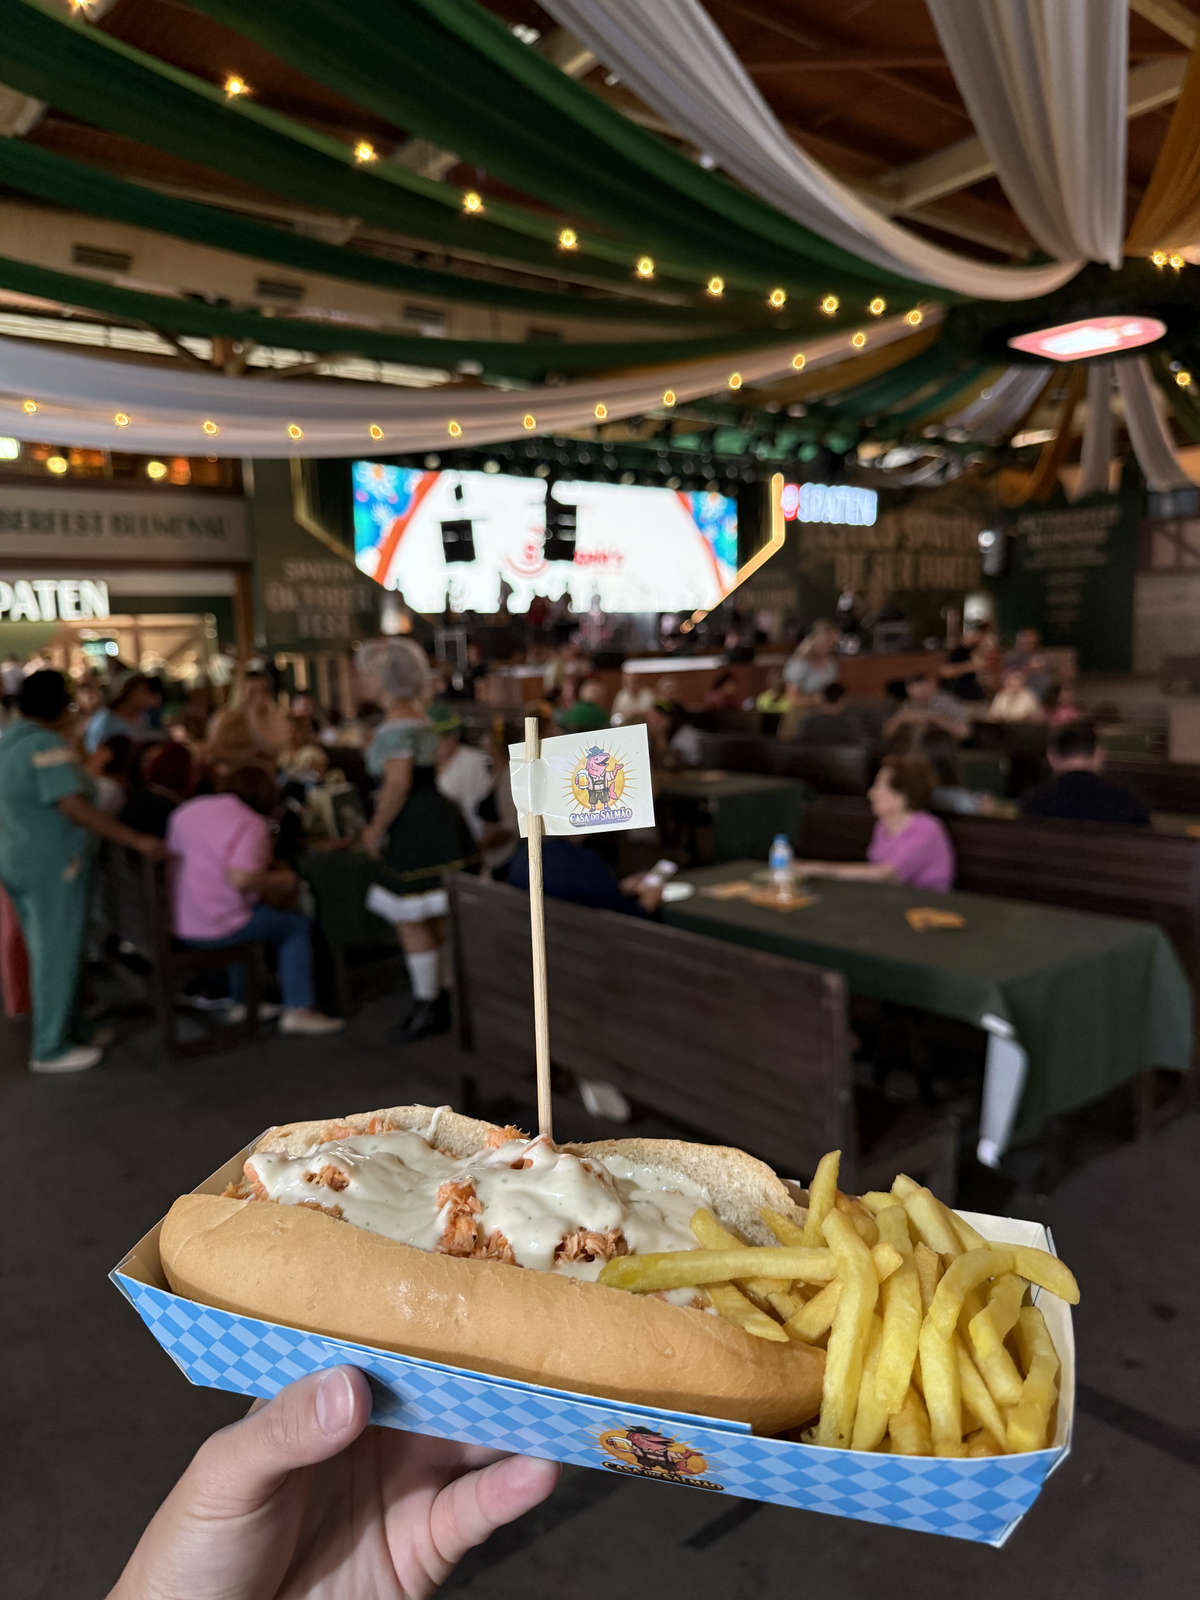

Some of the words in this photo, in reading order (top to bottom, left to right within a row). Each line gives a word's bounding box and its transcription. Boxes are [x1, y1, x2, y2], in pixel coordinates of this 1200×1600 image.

[798, 482, 878, 526] SPATEN
[0, 580, 110, 622] PATEN
[570, 813, 589, 823] CASA
[600, 808, 631, 820] SALMÃO
